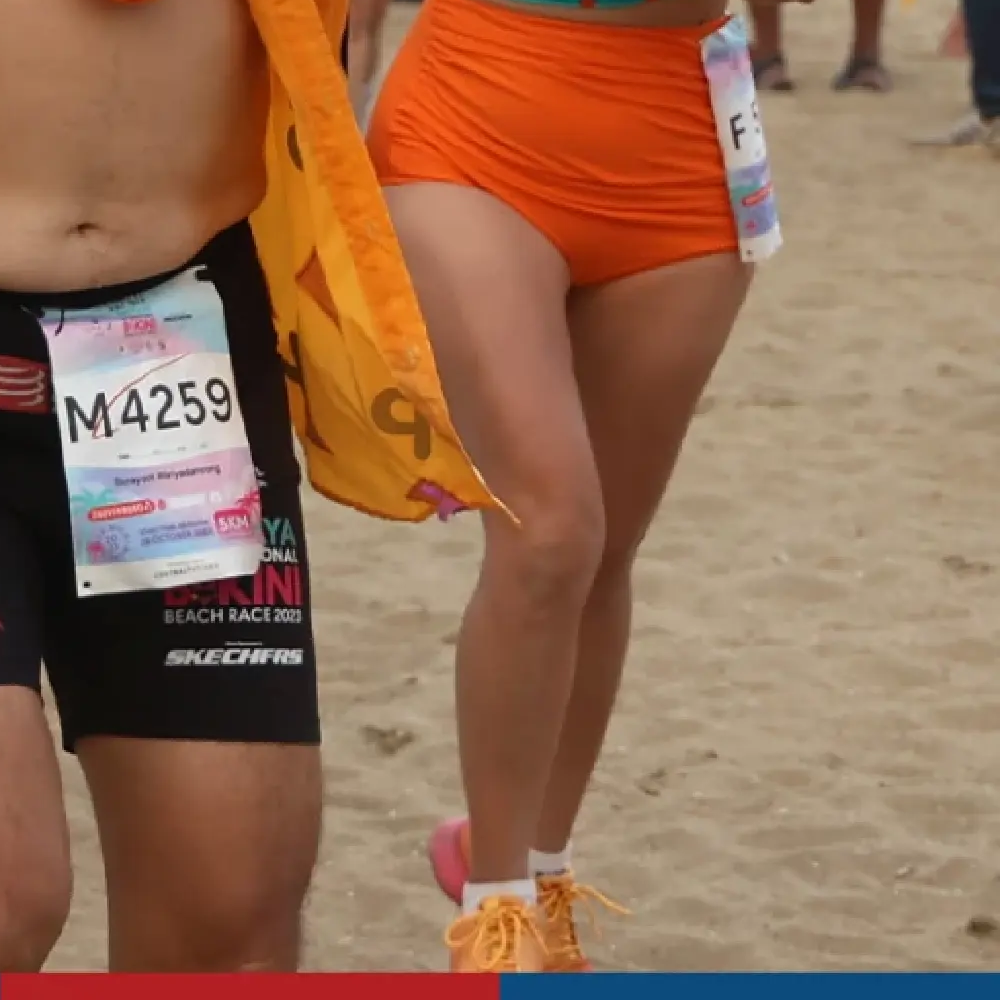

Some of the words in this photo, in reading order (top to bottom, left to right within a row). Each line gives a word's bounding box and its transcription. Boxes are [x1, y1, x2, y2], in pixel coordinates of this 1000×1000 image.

[64, 392, 113, 443] M
[121, 377, 232, 432] 4259
[164, 608, 224, 624] BEACH
[228, 608, 271, 623] RACE
